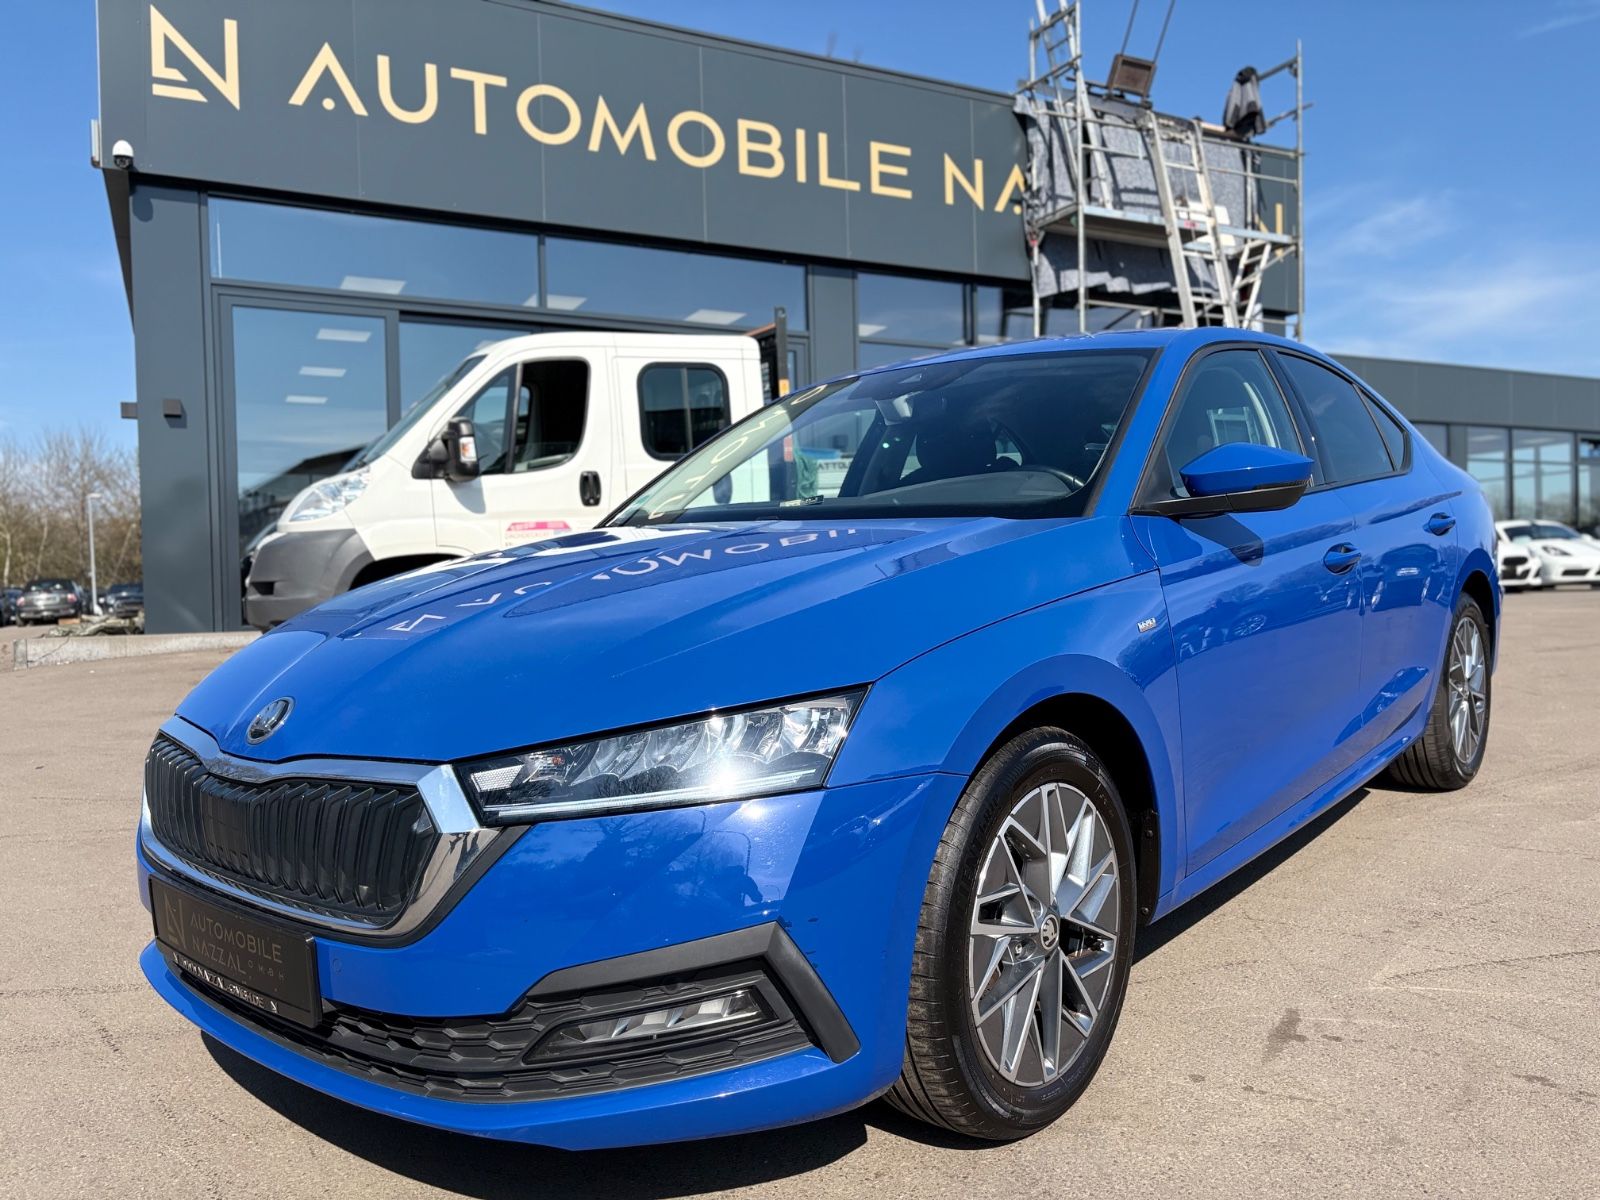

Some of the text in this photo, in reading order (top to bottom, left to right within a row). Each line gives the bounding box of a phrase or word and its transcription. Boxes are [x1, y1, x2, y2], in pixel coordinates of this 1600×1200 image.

[288, 41, 913, 200] AUTOMOBILE
[190, 911, 284, 964] AUTOMOBILE
[192, 935, 247, 976] NAZZAL
